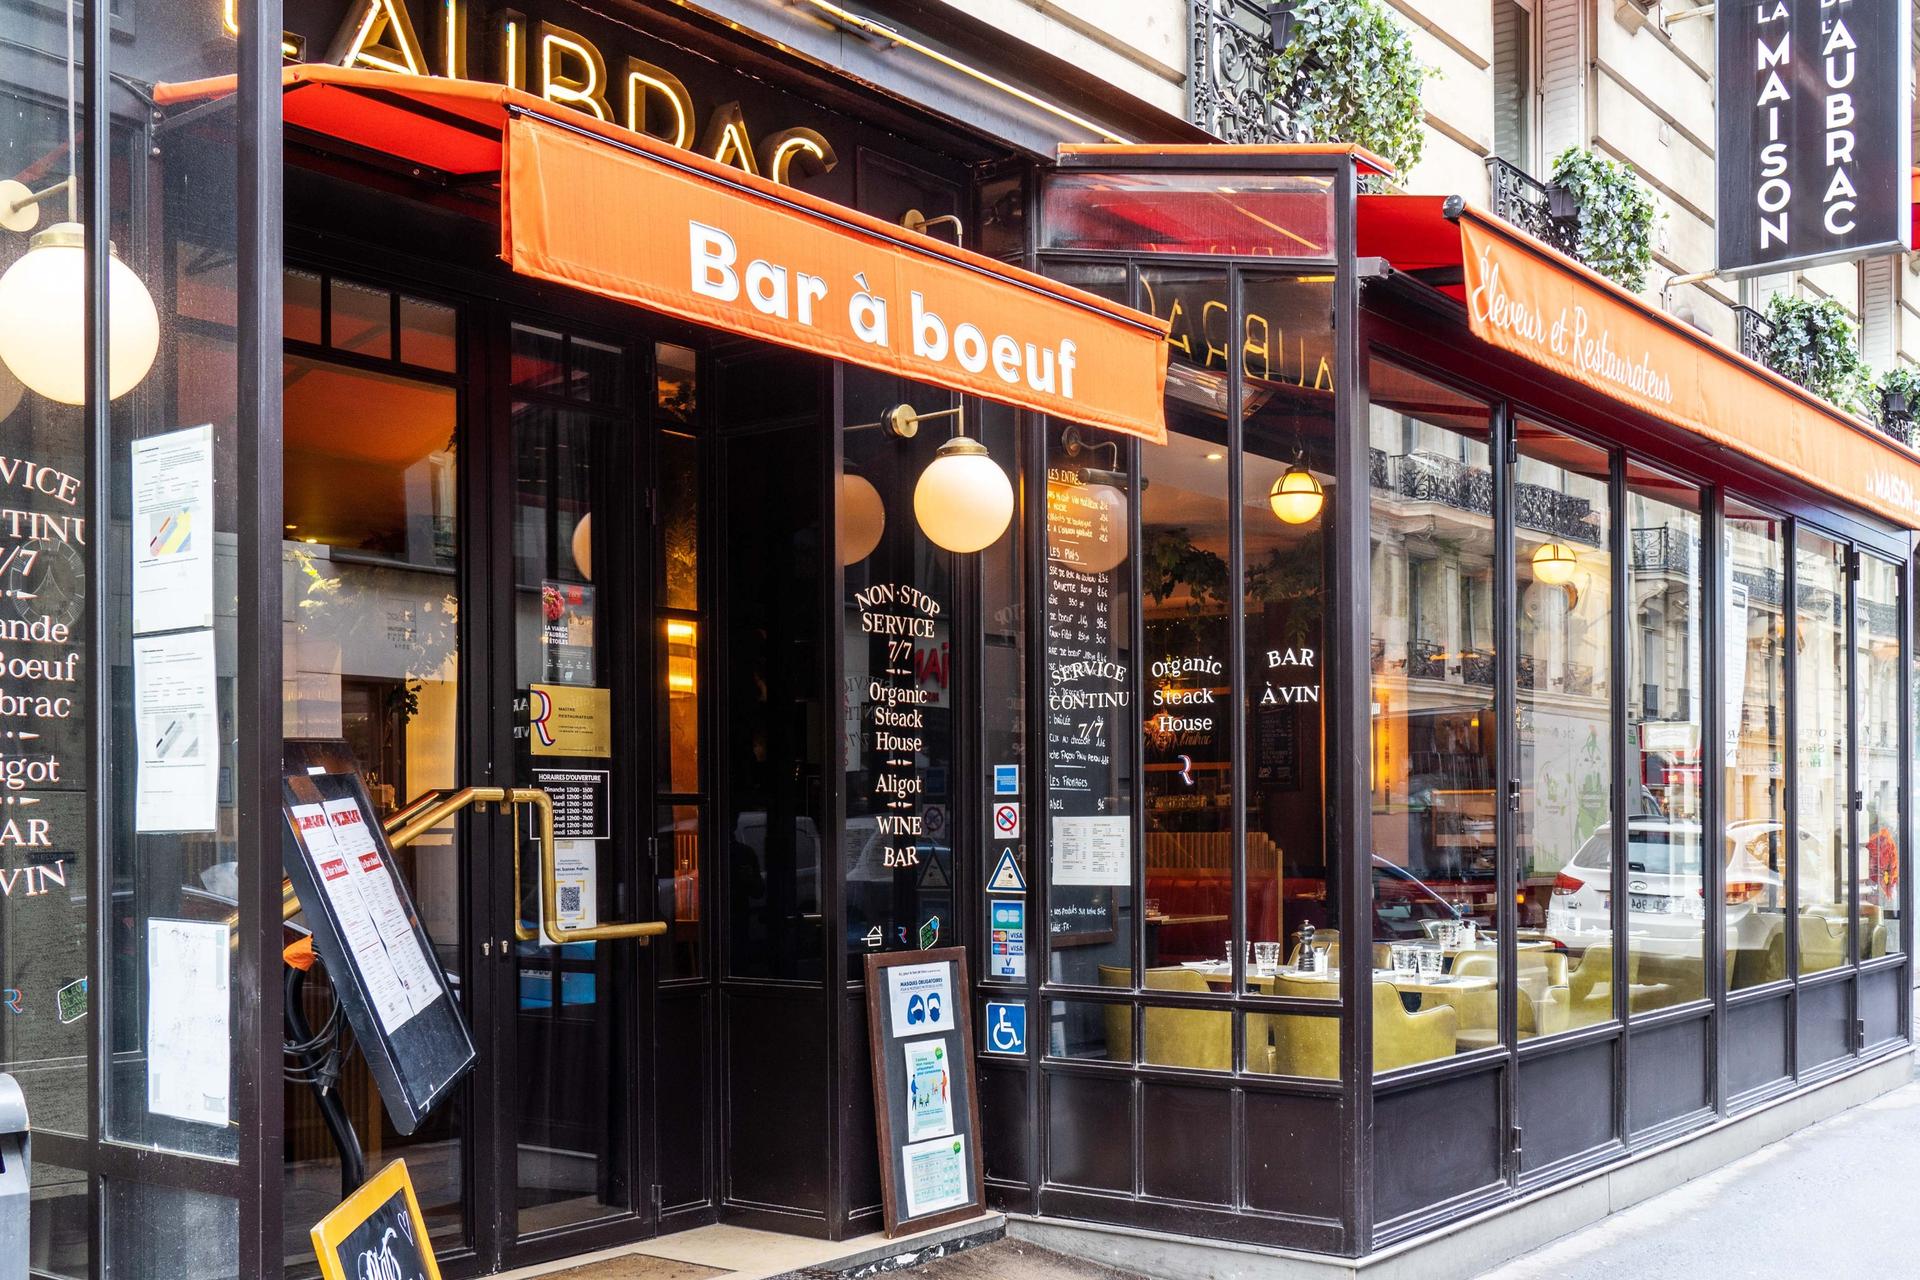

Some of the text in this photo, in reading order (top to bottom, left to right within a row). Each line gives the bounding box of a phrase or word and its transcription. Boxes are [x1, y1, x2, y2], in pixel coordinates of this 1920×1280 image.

[1757, 1, 1791, 249] LA MAISON
[689, 219, 1077, 399] Bar à boeuf
[1472, 245, 1673, 405] Éleveur et Restaurateur
[1050, 546, 1060, 558] LES
[862, 612, 935, 638] SERVICE
[888, 640, 912, 662] 7/7
[1266, 648, 1314, 668] BAR
[1051, 661, 1127, 686] SERVICE
[1151, 655, 1222, 678] Organic
[869, 682, 928, 707] Organic
[1050, 691, 1130, 711] CONTINU
[1152, 687, 1215, 706] Steack
[1261, 681, 1319, 704] À VIN
[875, 706, 923, 728] Steack
[1159, 716, 1213, 732] House
[1078, 720, 1104, 740] 7/7
[875, 731, 922, 752] House
[875, 774, 922, 798] Aligot
[876, 816, 922, 836] WINE
[883, 846, 919, 868] BAR
